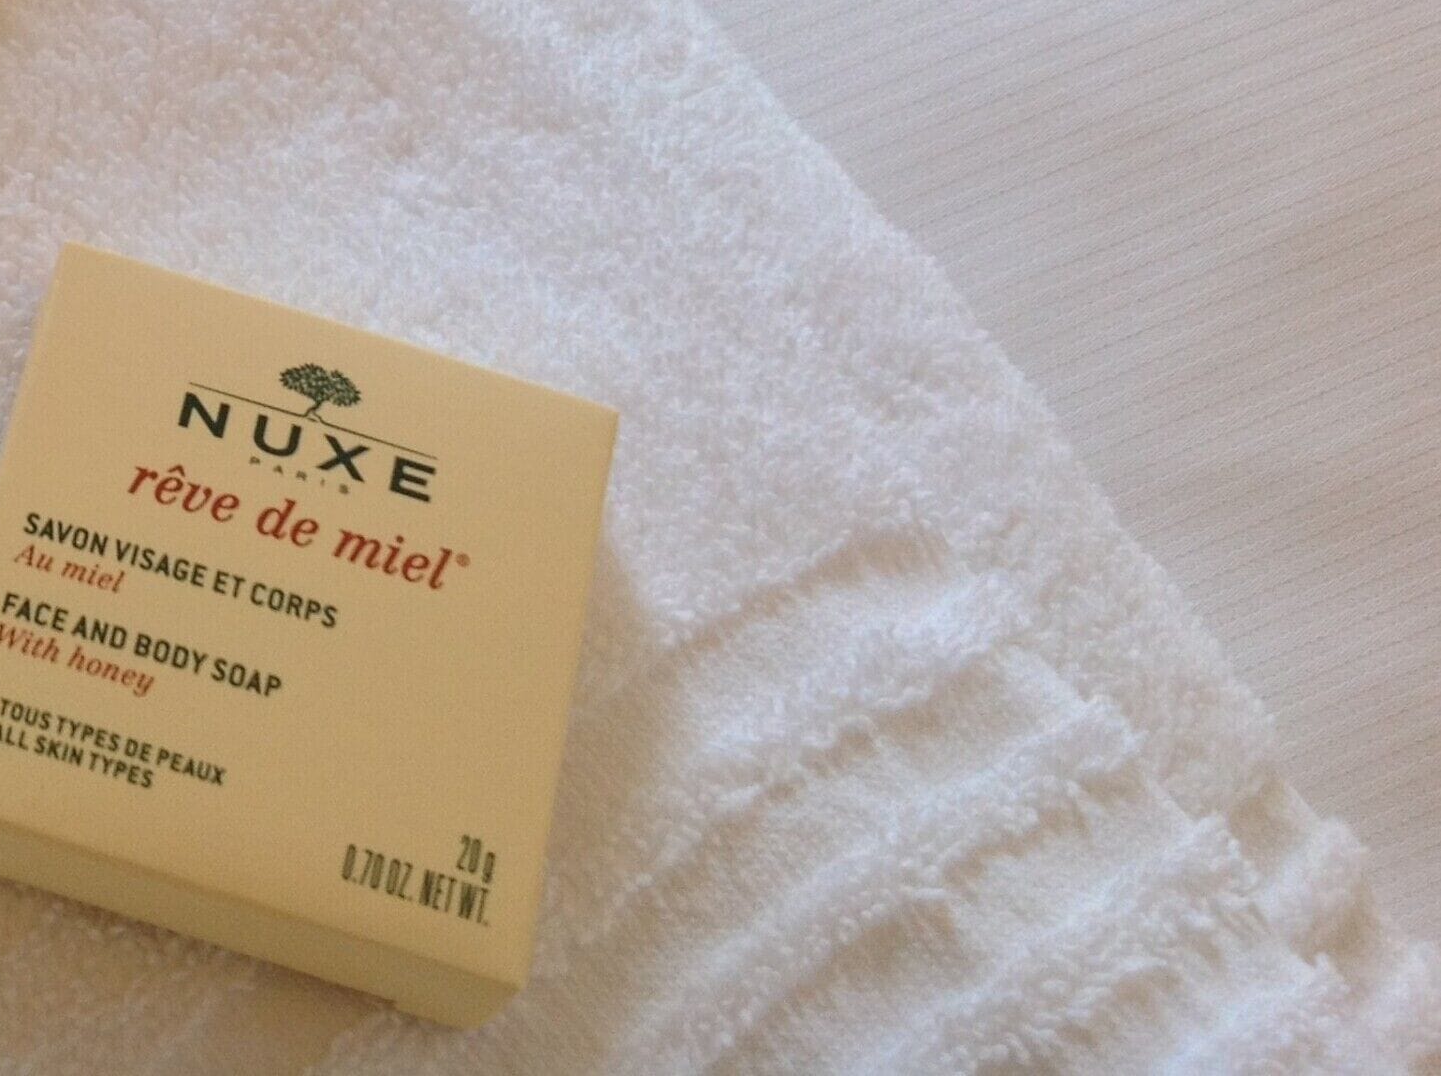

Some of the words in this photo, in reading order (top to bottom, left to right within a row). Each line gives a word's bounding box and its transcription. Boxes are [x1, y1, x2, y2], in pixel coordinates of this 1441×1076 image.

[177, 390, 438, 504] NUXE
[248, 455, 351, 496] PARIS
[127, 464, 241, 524] rêve
[256, 498, 320, 548] de
[14, 543, 53, 572] Au
[60, 558, 127, 594] miel
[24, 512, 109, 557] SAVON
[115, 537, 209, 588] VISAGE
[213, 570, 247, 599] ET
[249, 581, 339, 629] CORPS
[1, 592, 70, 633] FACE
[71, 615, 129, 651] AND
[133, 632, 210, 676] BODY
[210, 657, 282, 698] SOAP
[66, 645, 156, 698] honey
[34, 735, 83, 769] SKIN
[87, 752, 155, 789] TYPES
[56, 714, 121, 754] TYPES
[124, 737, 152, 763] DE
[157, 748, 228, 787] PEAUX
[341, 843, 385, 890] 0.70
[418, 868, 457, 913] NET
[456, 833, 482, 874] 20
